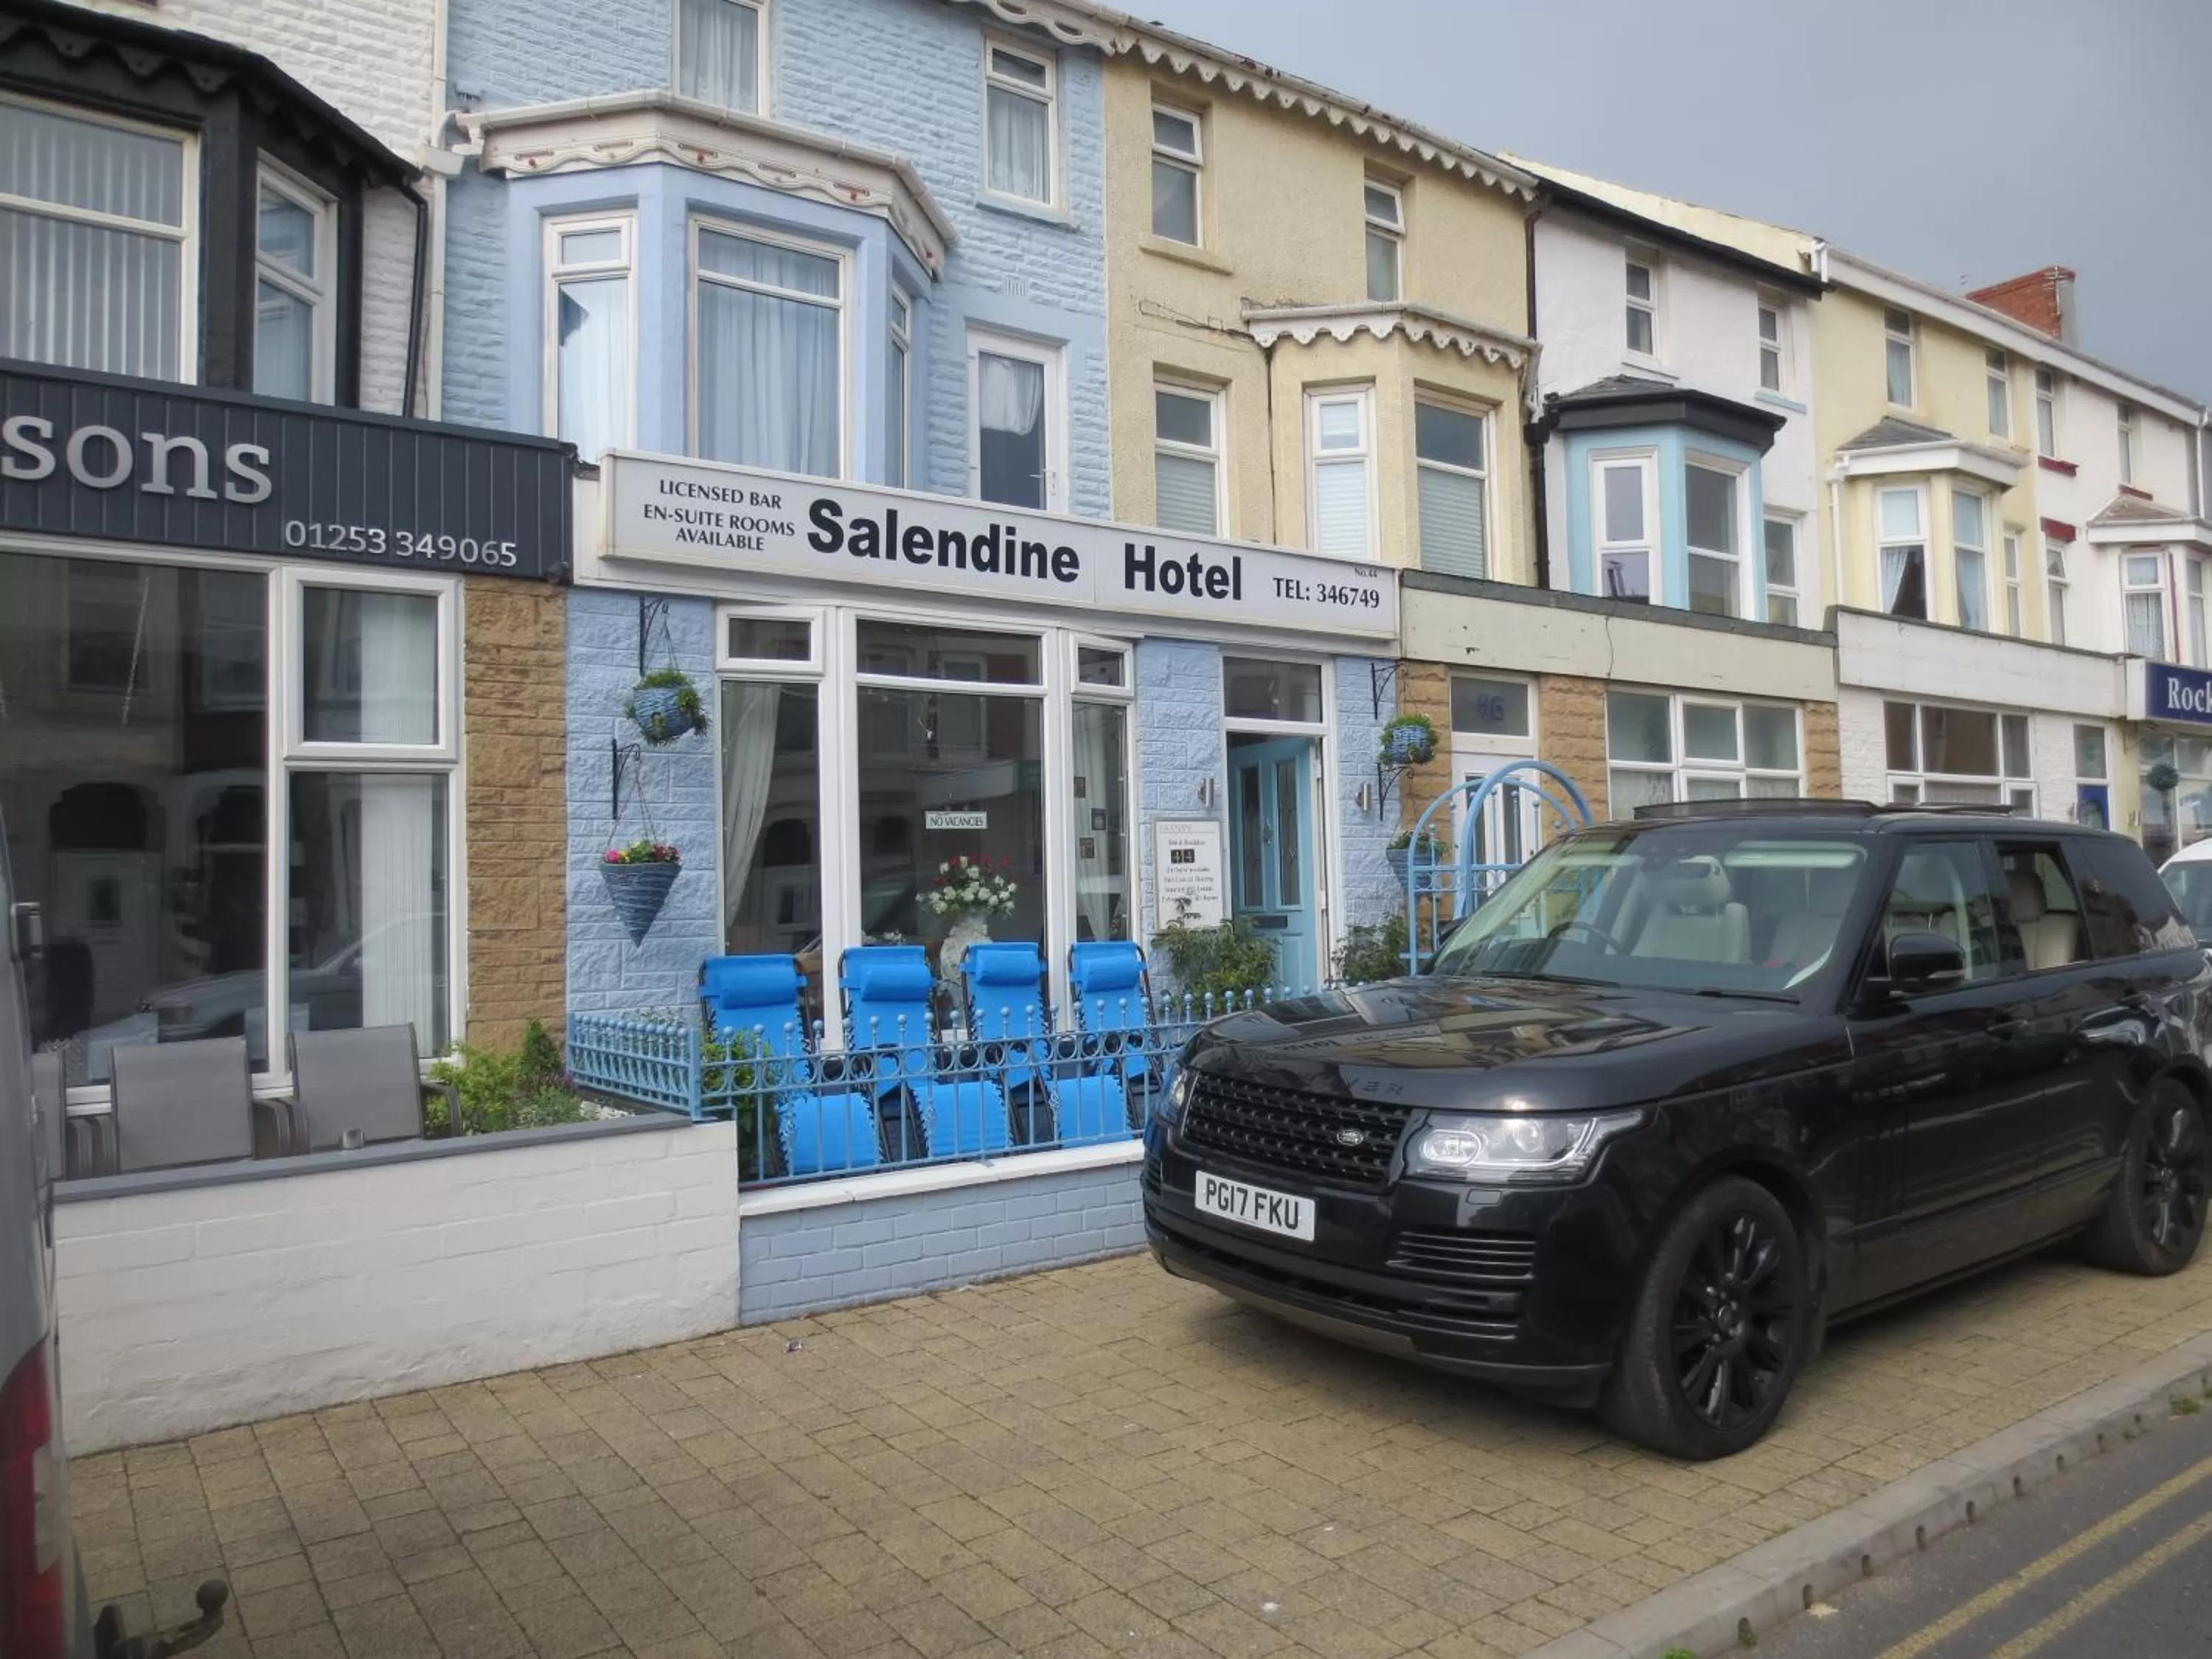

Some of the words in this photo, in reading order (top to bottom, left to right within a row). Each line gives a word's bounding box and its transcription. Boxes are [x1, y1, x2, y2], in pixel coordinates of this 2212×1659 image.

[3, 415, 272, 504] sons
[660, 479, 744, 504] LICENSED
[750, 491, 782, 509] BAR
[644, 504, 723, 528] EN-SUITE
[728, 515, 796, 537] ROOMS
[285, 521, 386, 554] 01253
[396, 531, 517, 567] 349065
[675, 527, 765, 552] AVAILABLE
[807, 498, 1079, 582] Salendine
[1124, 542, 1242, 601] Hotel
[1272, 577, 1311, 601] TEL:
[1316, 583, 1380, 609] 346749
[930, 815, 944, 827] NO
[1206, 1179, 1248, 1216] PG17
[1254, 1192, 1298, 1230] FKU
